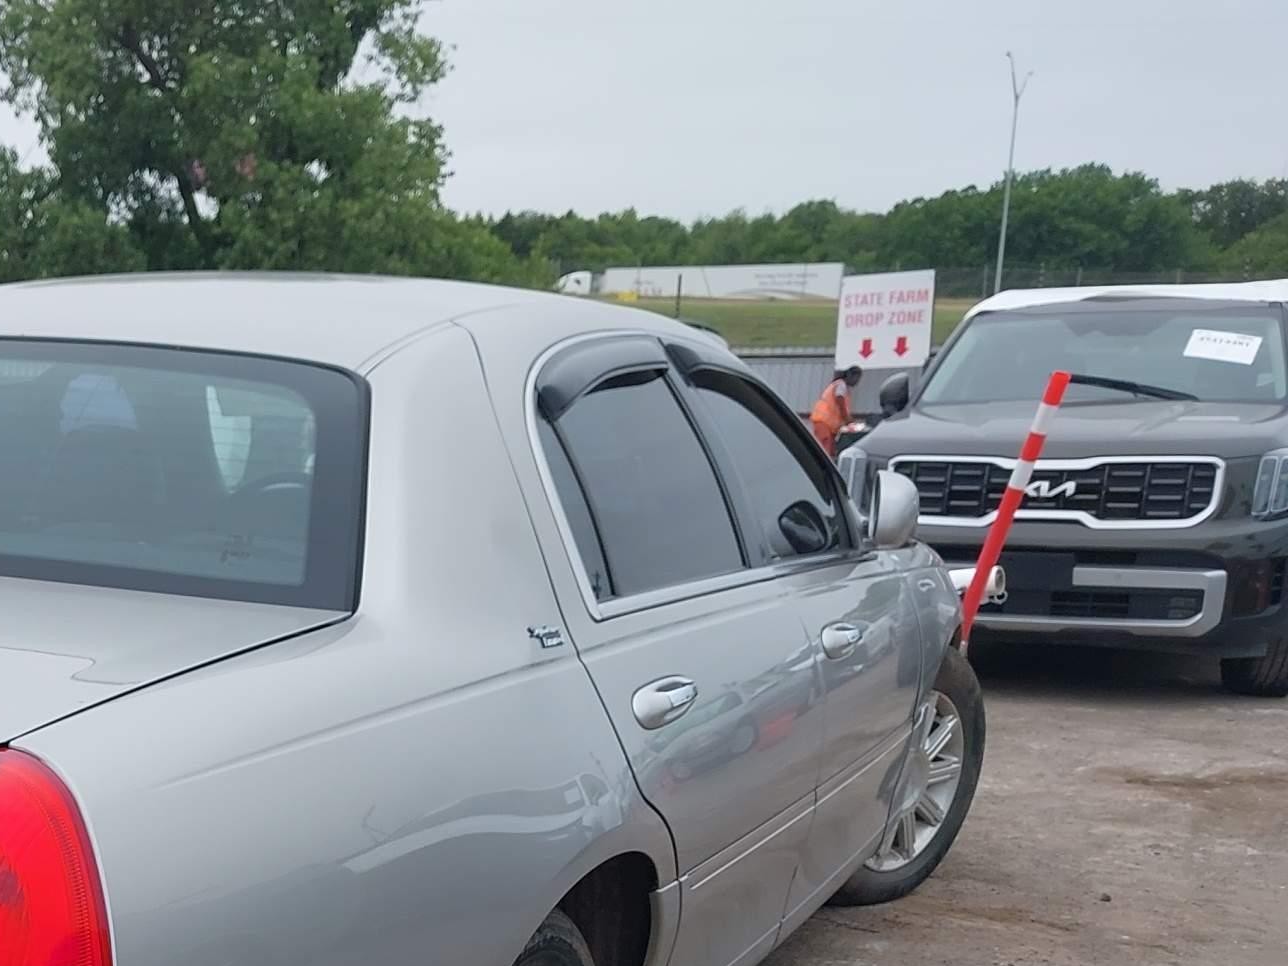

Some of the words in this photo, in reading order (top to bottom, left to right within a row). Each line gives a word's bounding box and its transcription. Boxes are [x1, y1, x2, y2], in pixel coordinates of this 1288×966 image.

[844, 291, 884, 309] STATE
[888, 288, 930, 305] FARM
[845, 311, 884, 329] DROP
[888, 309, 926, 326] ZONE
